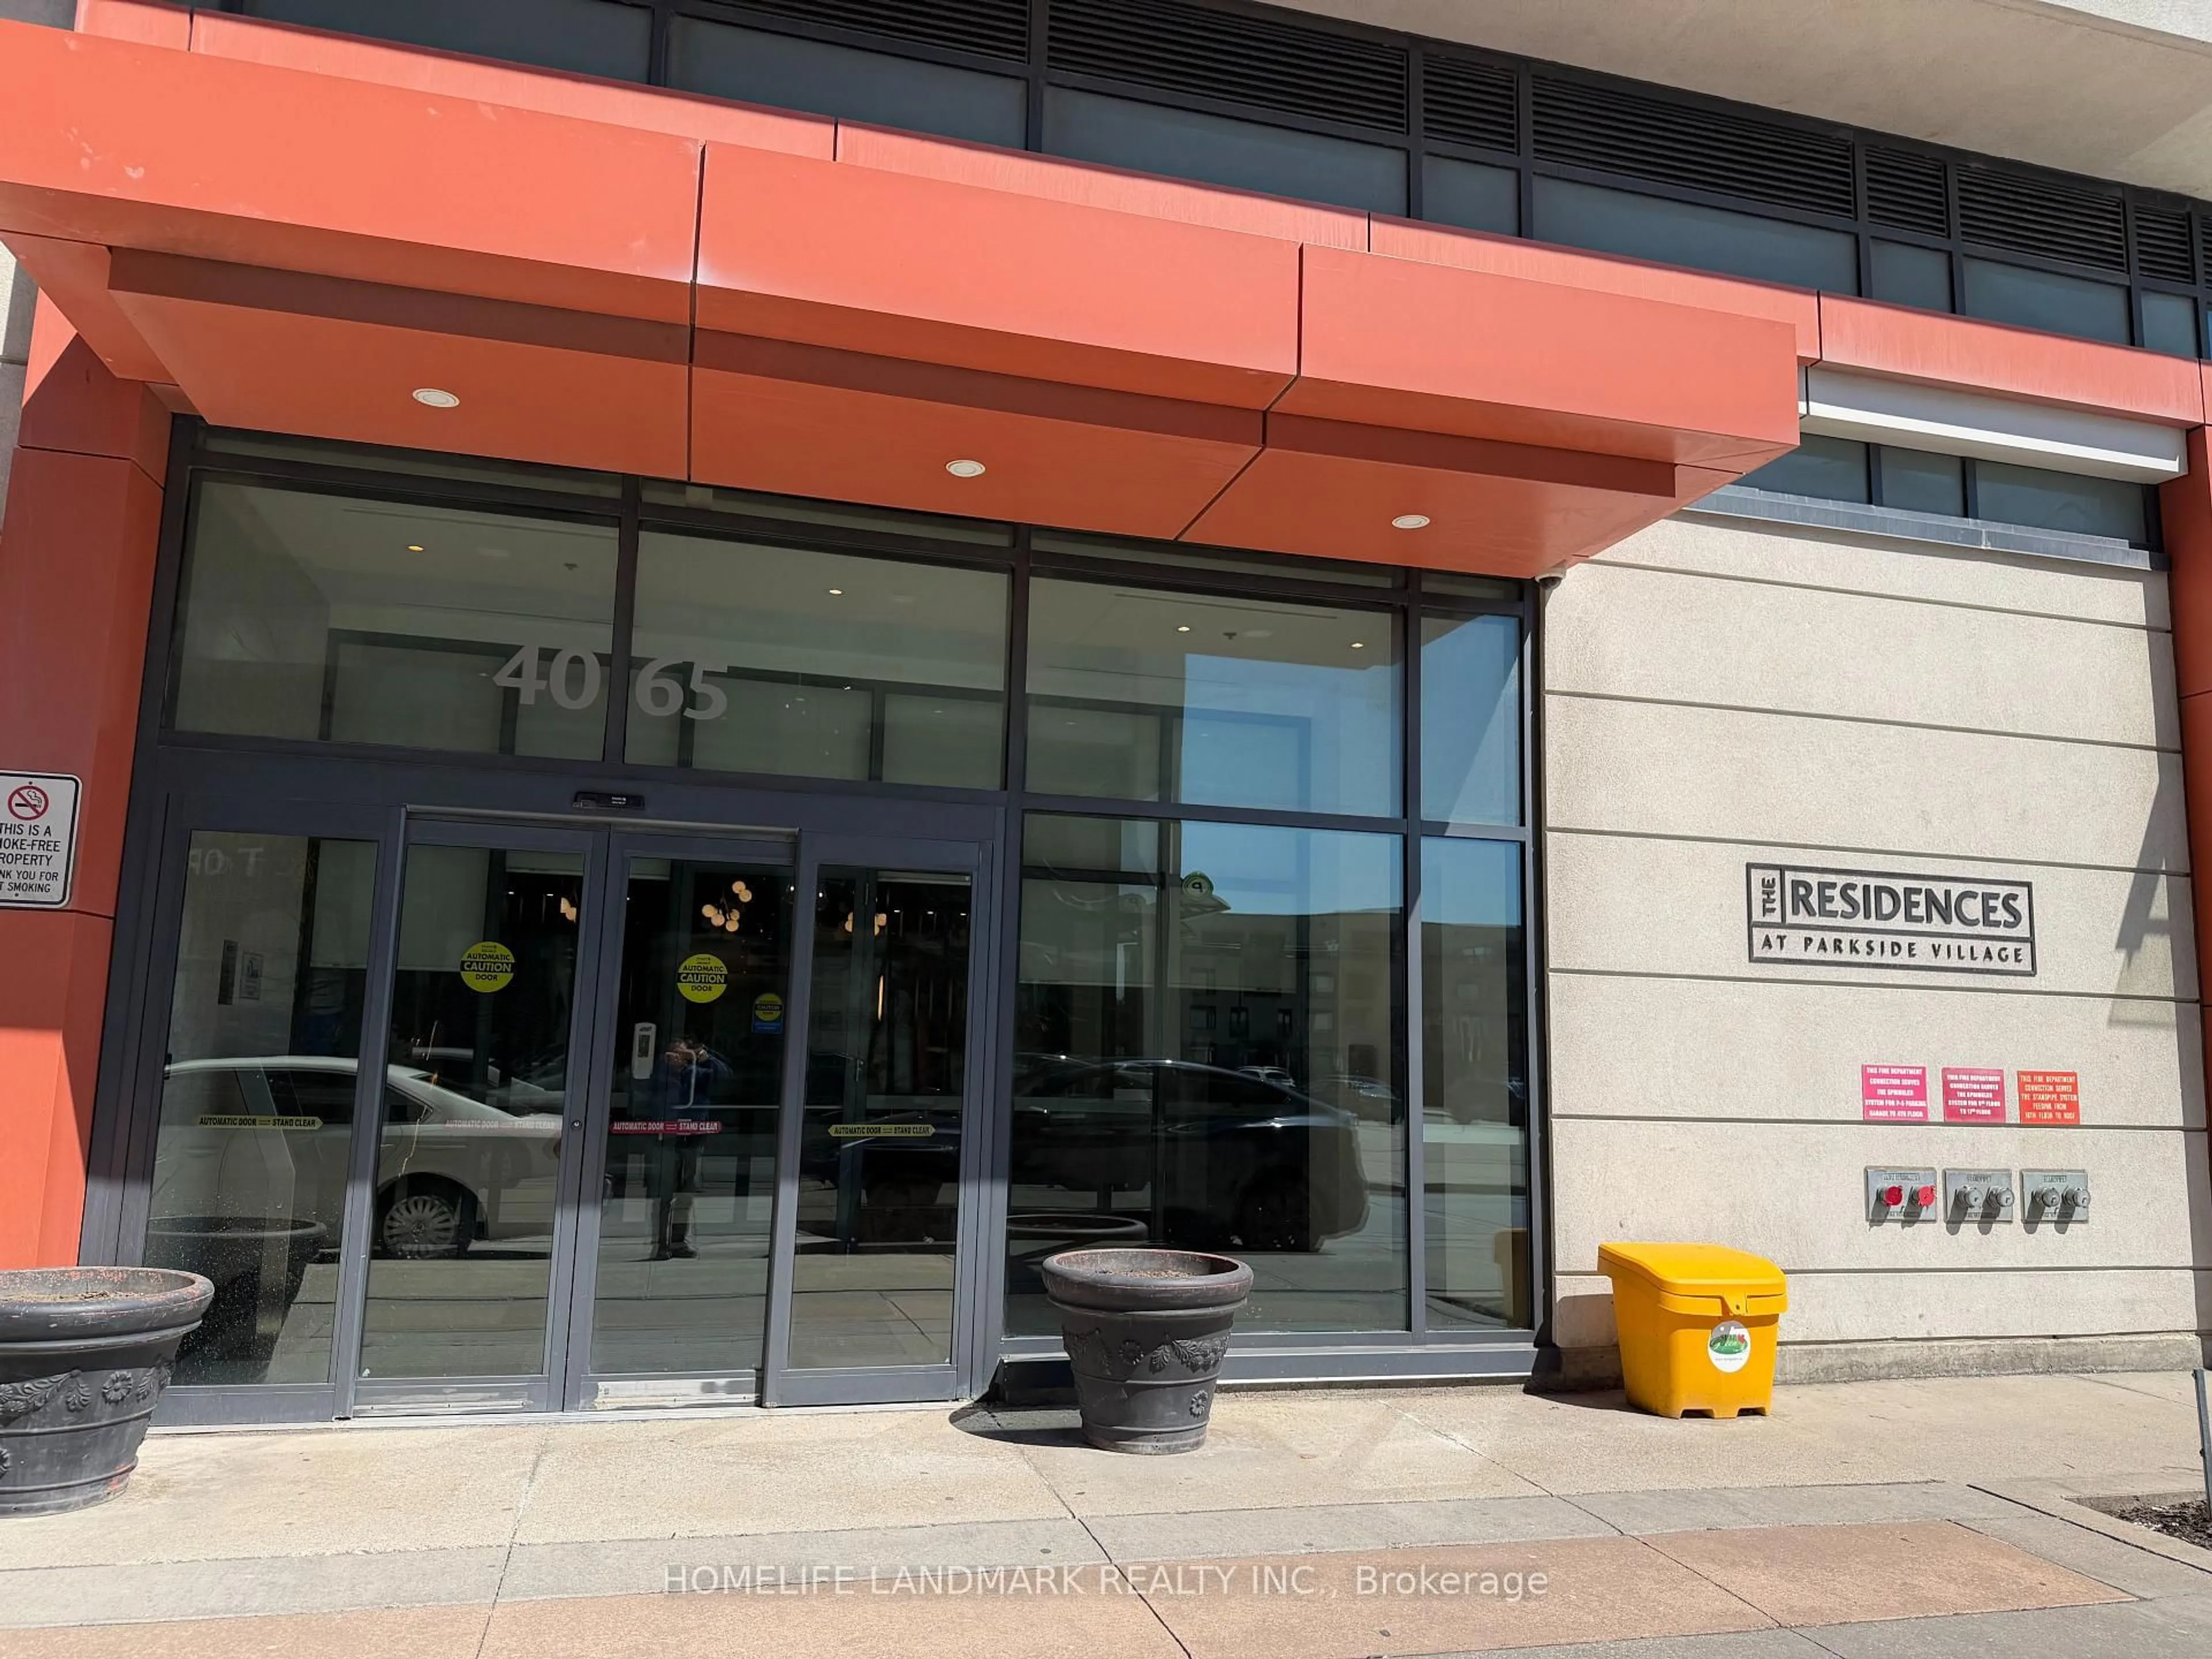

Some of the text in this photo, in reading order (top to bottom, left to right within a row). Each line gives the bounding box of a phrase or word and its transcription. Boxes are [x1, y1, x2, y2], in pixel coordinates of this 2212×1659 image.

[0, 823, 51, 837] THIS IS A
[0, 838, 61, 852] OKE-FREE
[0, 853, 52, 866] ROPERTY
[16, 870, 35, 880] YOU
[40, 872, 58, 881] FOR
[7, 882, 51, 893] SMOKING
[1762, 877, 2022, 929] THE RESIDENCES
[1762, 934, 2023, 963] AT PARKSIDE VILLAGE
[464, 962, 512, 972] CAUTION
[680, 974, 725, 983] CAUTION
[199, 1117, 316, 1127] AUTOMATIC DOOR STAND CLEAR
[445, 1119, 555, 1129] AUTOMATIC DOOR STAND CLEAR
[613, 1122, 717, 1131] AUTOMATIC DOOR STAND CLEAR
[834, 1126, 866, 1134] AUTOMATIC
